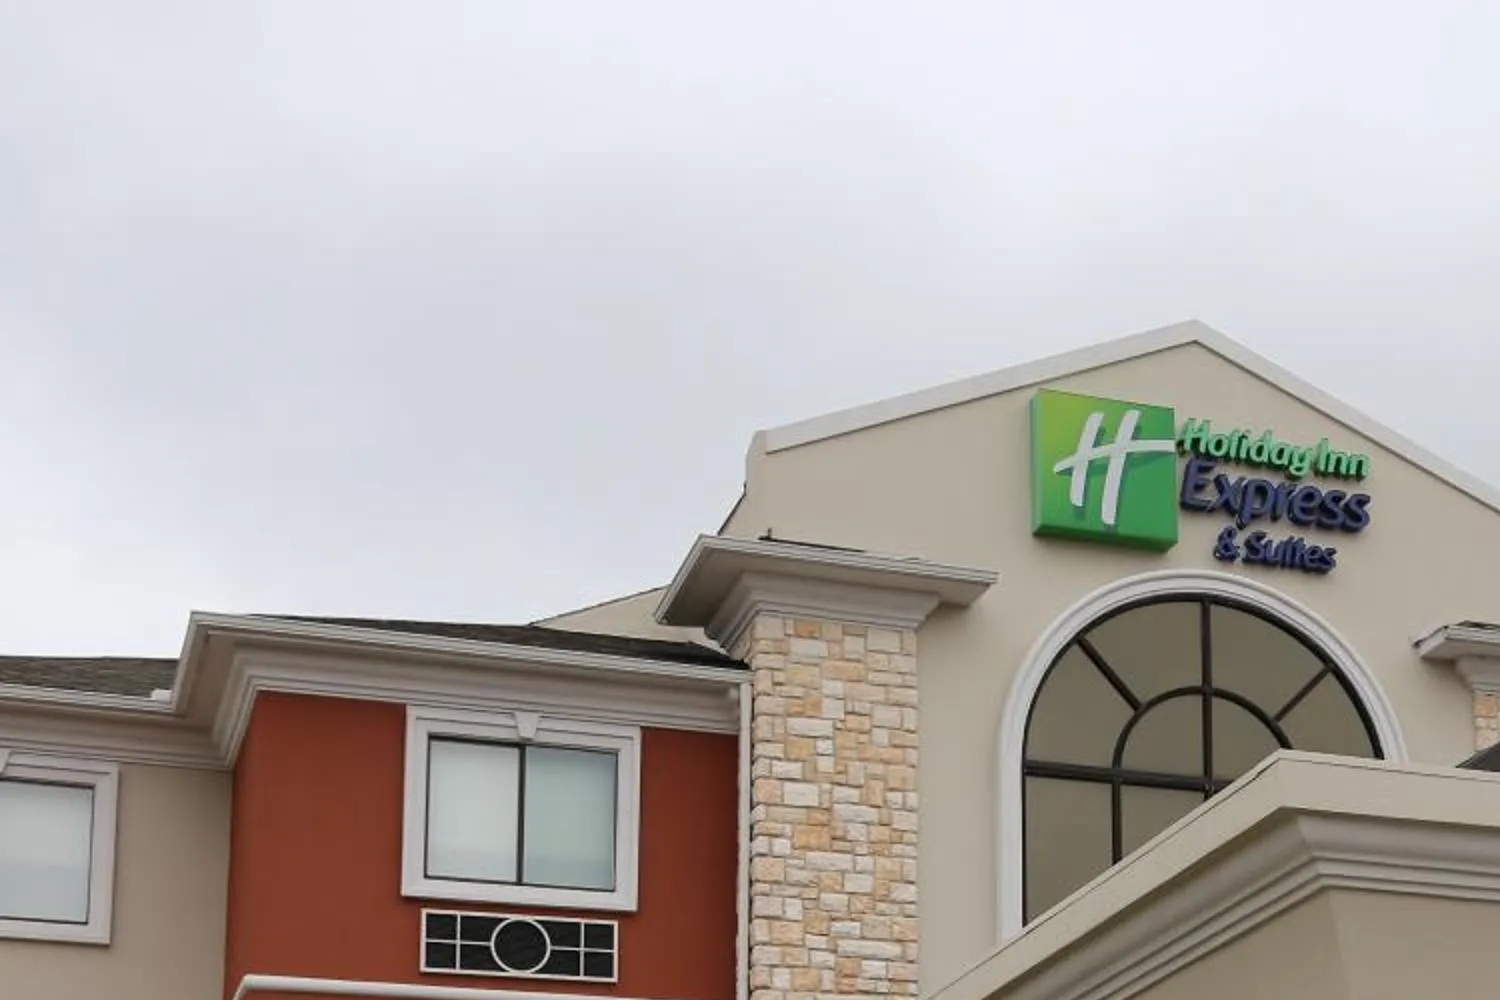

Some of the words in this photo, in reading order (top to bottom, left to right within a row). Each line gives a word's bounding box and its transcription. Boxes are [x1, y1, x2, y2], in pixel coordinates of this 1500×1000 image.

[1182, 418, 1312, 477] Holiday
[1315, 438, 1371, 479] Inn
[1181, 459, 1372, 532] Express
[1214, 525, 1240, 562] &
[1243, 531, 1337, 574] Suites
